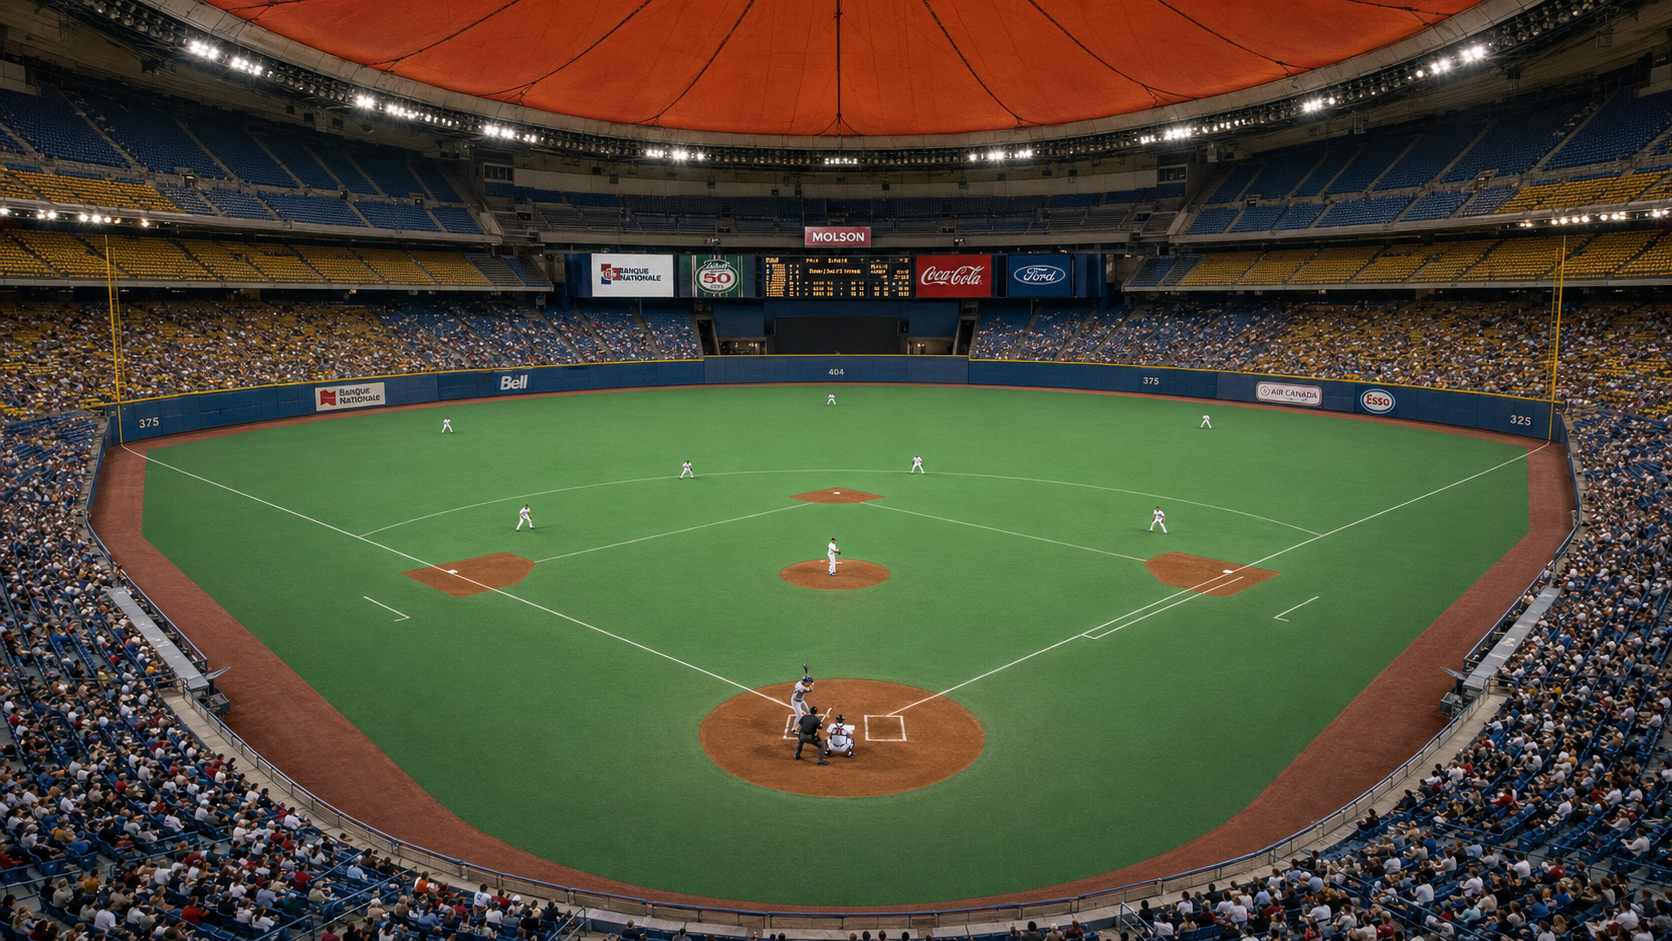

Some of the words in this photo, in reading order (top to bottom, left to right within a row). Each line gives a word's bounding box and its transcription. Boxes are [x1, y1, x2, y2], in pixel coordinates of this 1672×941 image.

[812, 231, 865, 242] MOLSON
[619, 274, 662, 282] NATIONALE
[703, 272, 732, 284] 50
[920, 265, 985, 286] Coca-Cola
[1023, 267, 1057, 281] Ford
[828, 368, 845, 376] 404
[500, 374, 529, 390] Bell
[1142, 376, 1160, 386] 375
[1270, 388, 1284, 396] AIR
[1284, 389, 1318, 399] CANADA
[138, 416, 160, 429] 375
[1509, 414, 1532, 426] 325
